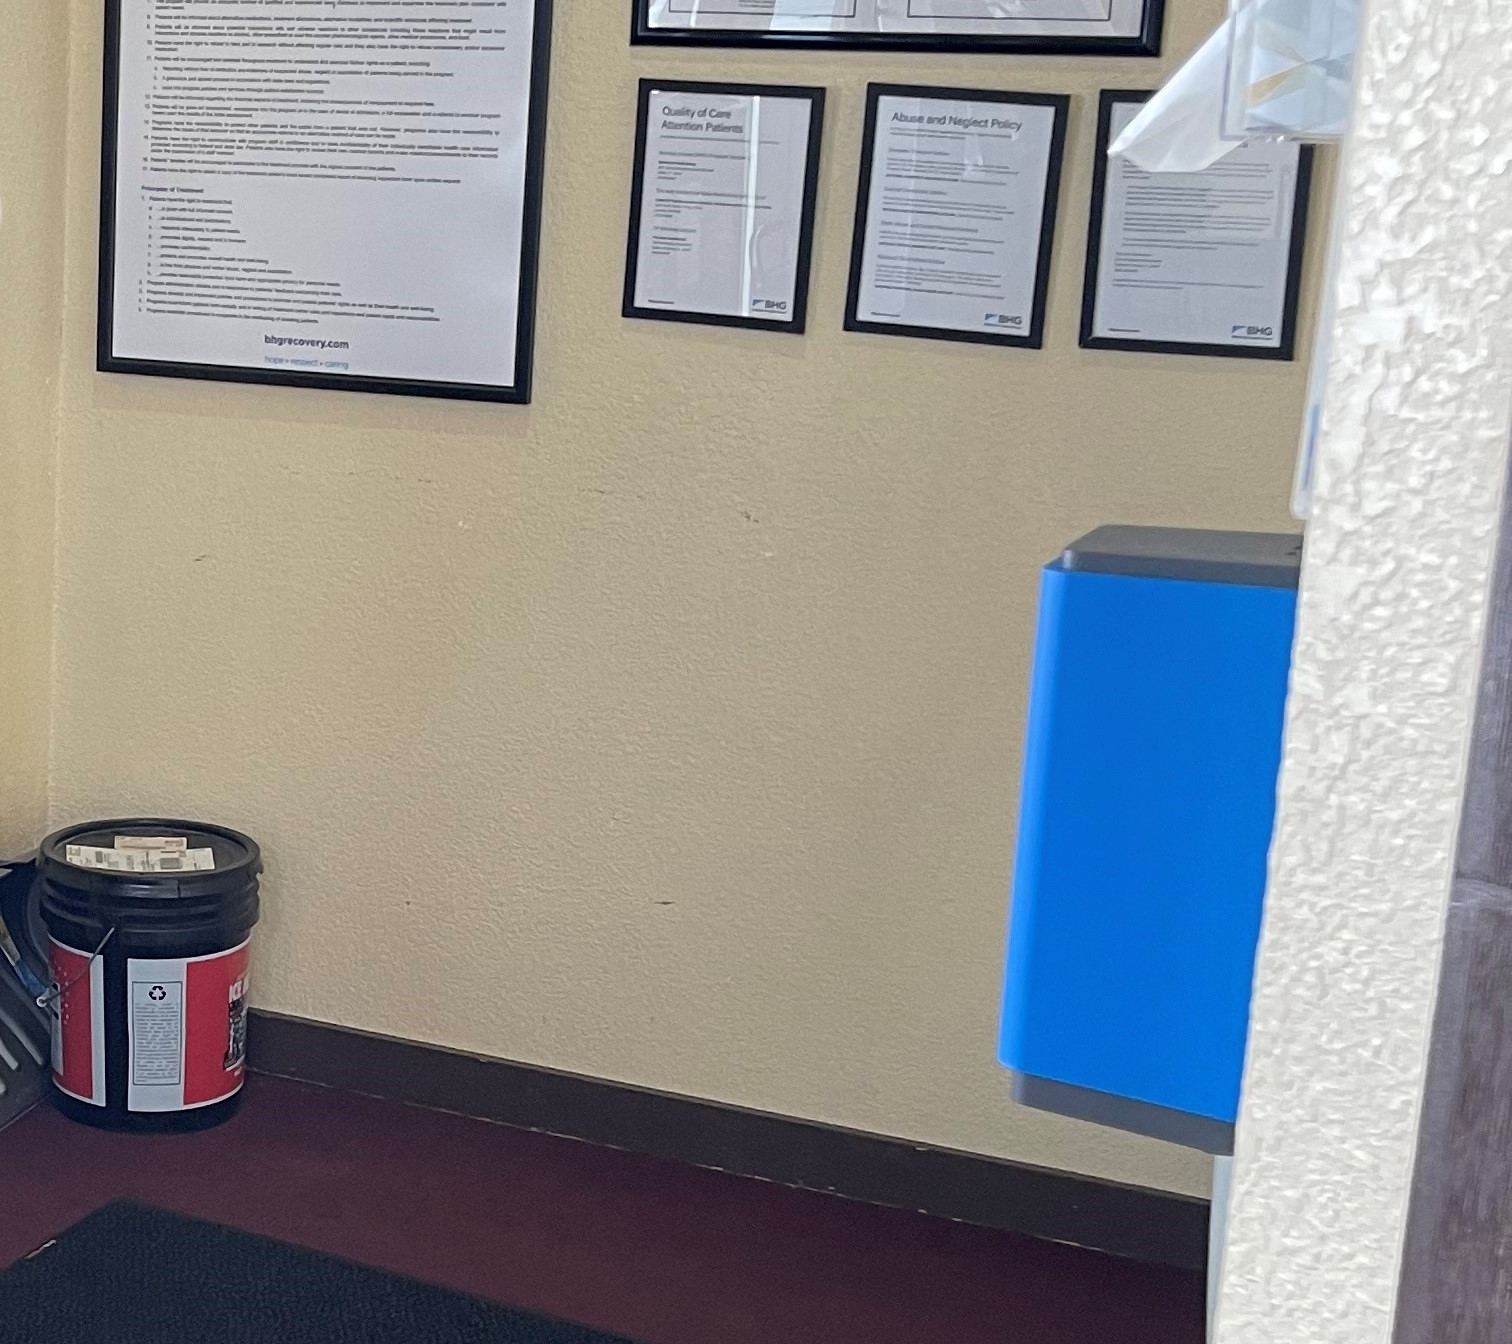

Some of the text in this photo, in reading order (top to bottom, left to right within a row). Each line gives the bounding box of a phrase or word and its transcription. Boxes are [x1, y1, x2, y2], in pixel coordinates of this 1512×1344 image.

[661, 106, 732, 120] Quality of Care
[661, 119, 744, 134] Attention Patients
[891, 111, 1022, 132] Abuse and Neglect Policy
[764, 299, 787, 310] BHG
[998, 313, 1023, 325] BHG
[1246, 326, 1273, 336] BHG
[264, 335, 349, 349] bhgrecovery.com
